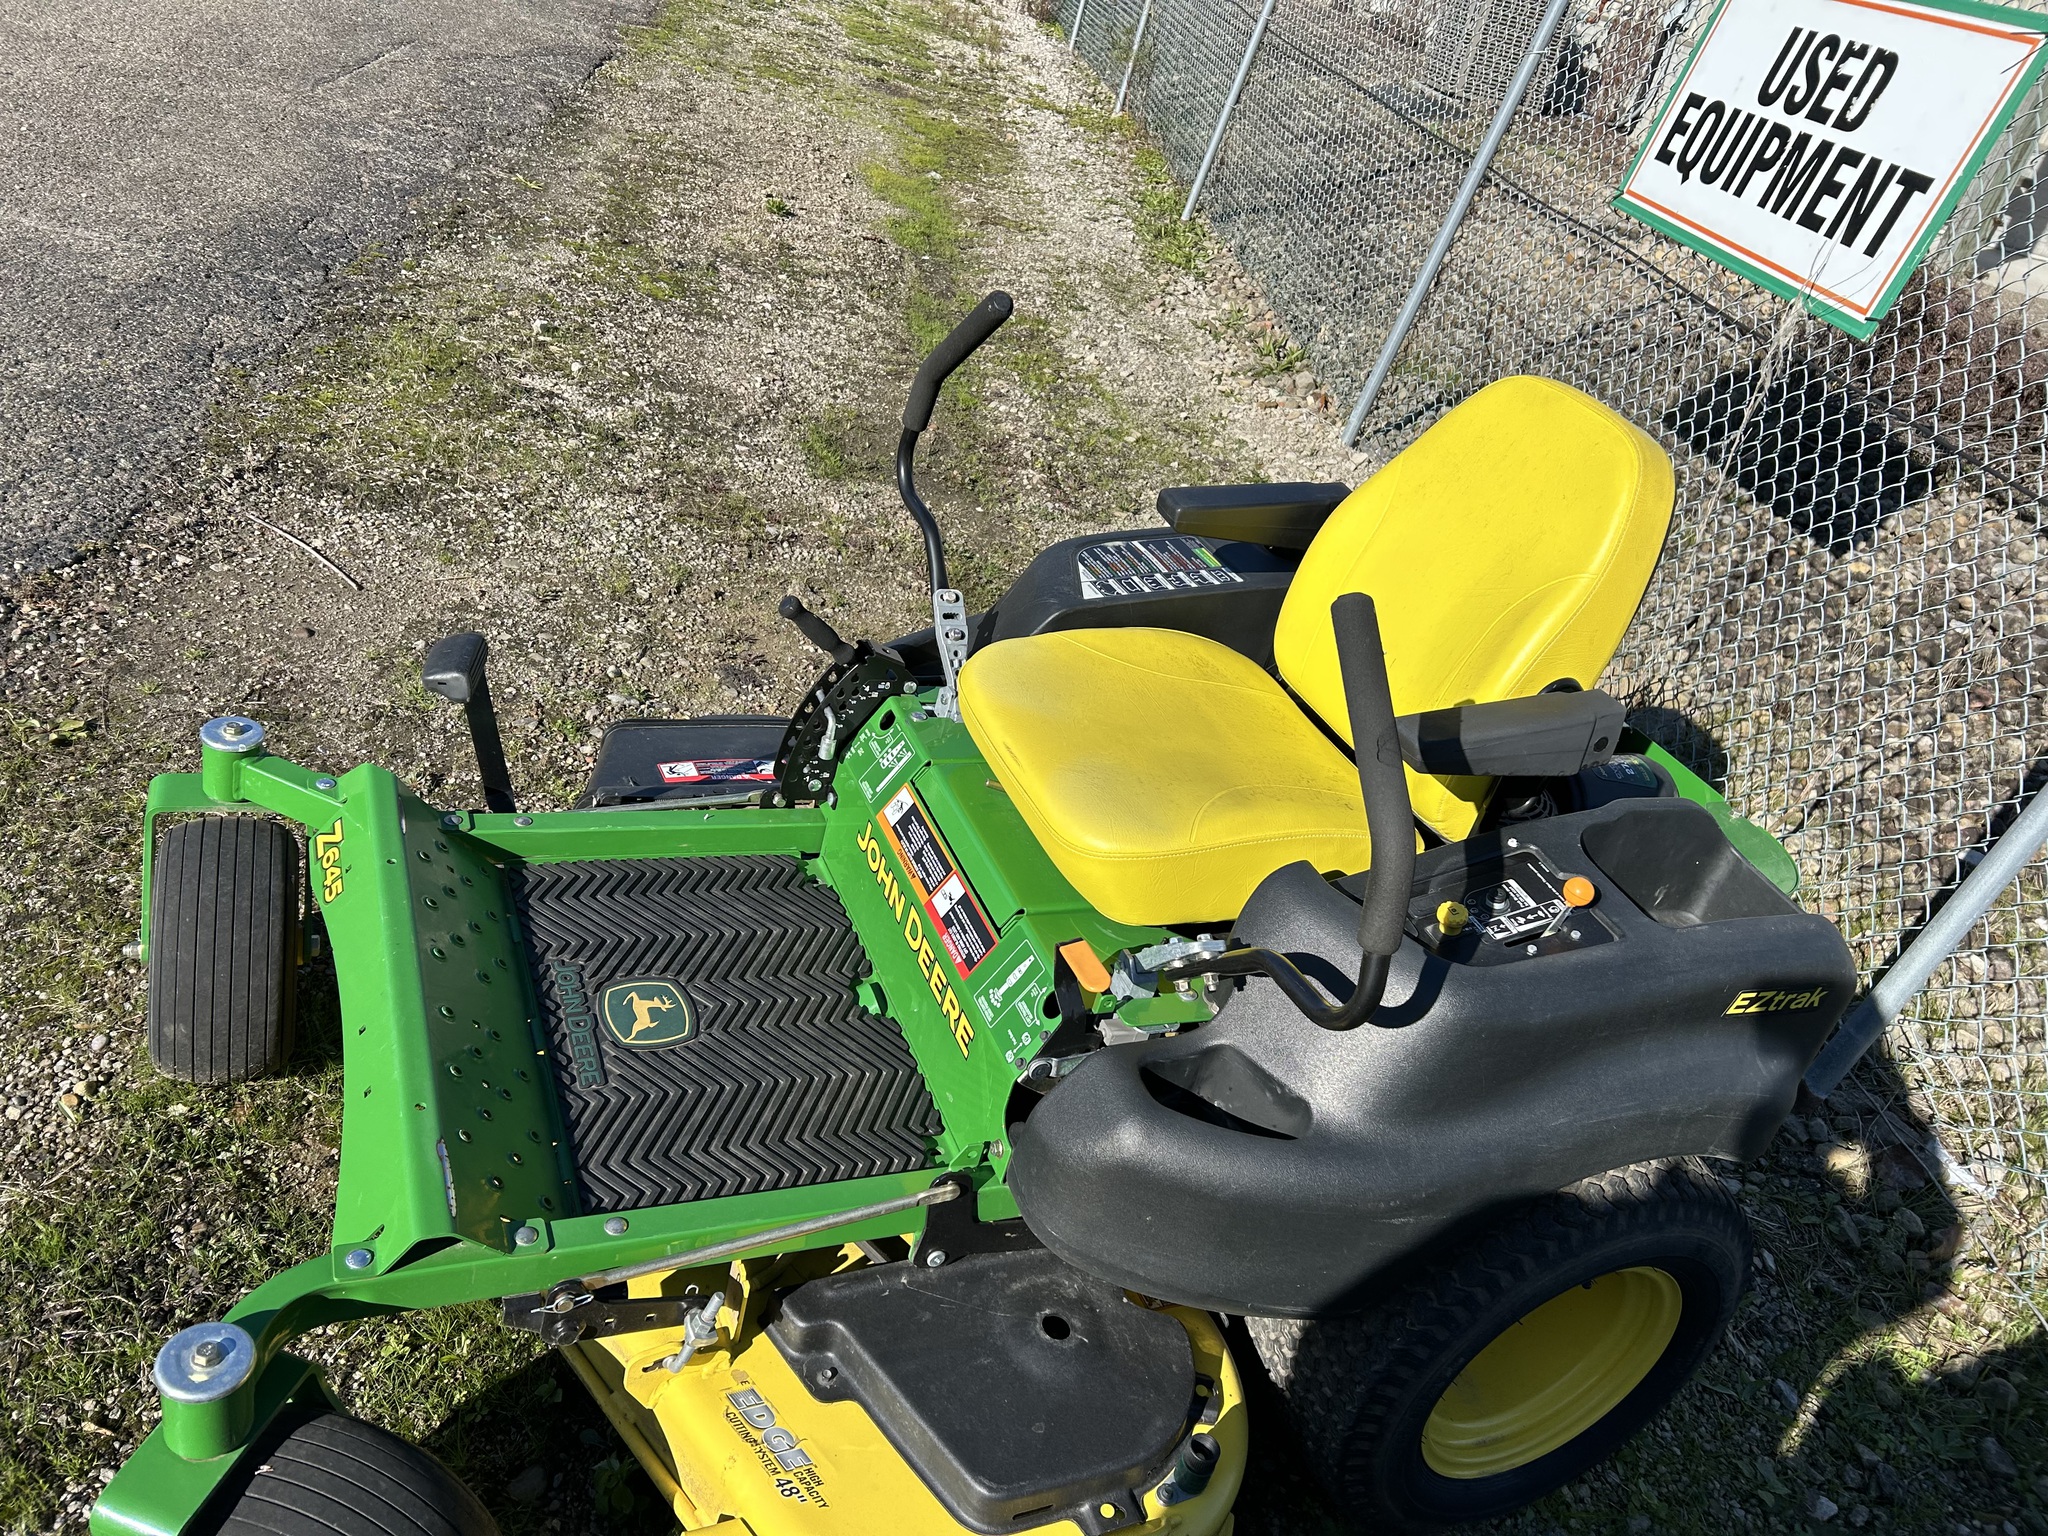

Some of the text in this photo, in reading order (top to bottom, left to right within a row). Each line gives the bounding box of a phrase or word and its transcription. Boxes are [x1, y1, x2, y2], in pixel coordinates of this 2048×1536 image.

[1757, 26, 1899, 132] USED
[1654, 92, 1936, 258] EQUIPMENT
[315, 817, 345, 904] Z645
[896, 848, 913, 875] WARNING
[856, 822, 908, 925] JOHN
[904, 902, 976, 1061] DEERE
[942, 931, 959, 959] DANGER
[552, 960, 601, 1086] JOHN DEERE
[1725, 986, 1829, 1015] EZtrak
[725, 1386, 814, 1472] EDGE
[726, 1410, 758, 1444] CUTTING
[751, 1439, 781, 1476] SYSTEM
[793, 1471, 830, 1510] CAPACITY
[803, 1467, 825, 1488] HIGH
